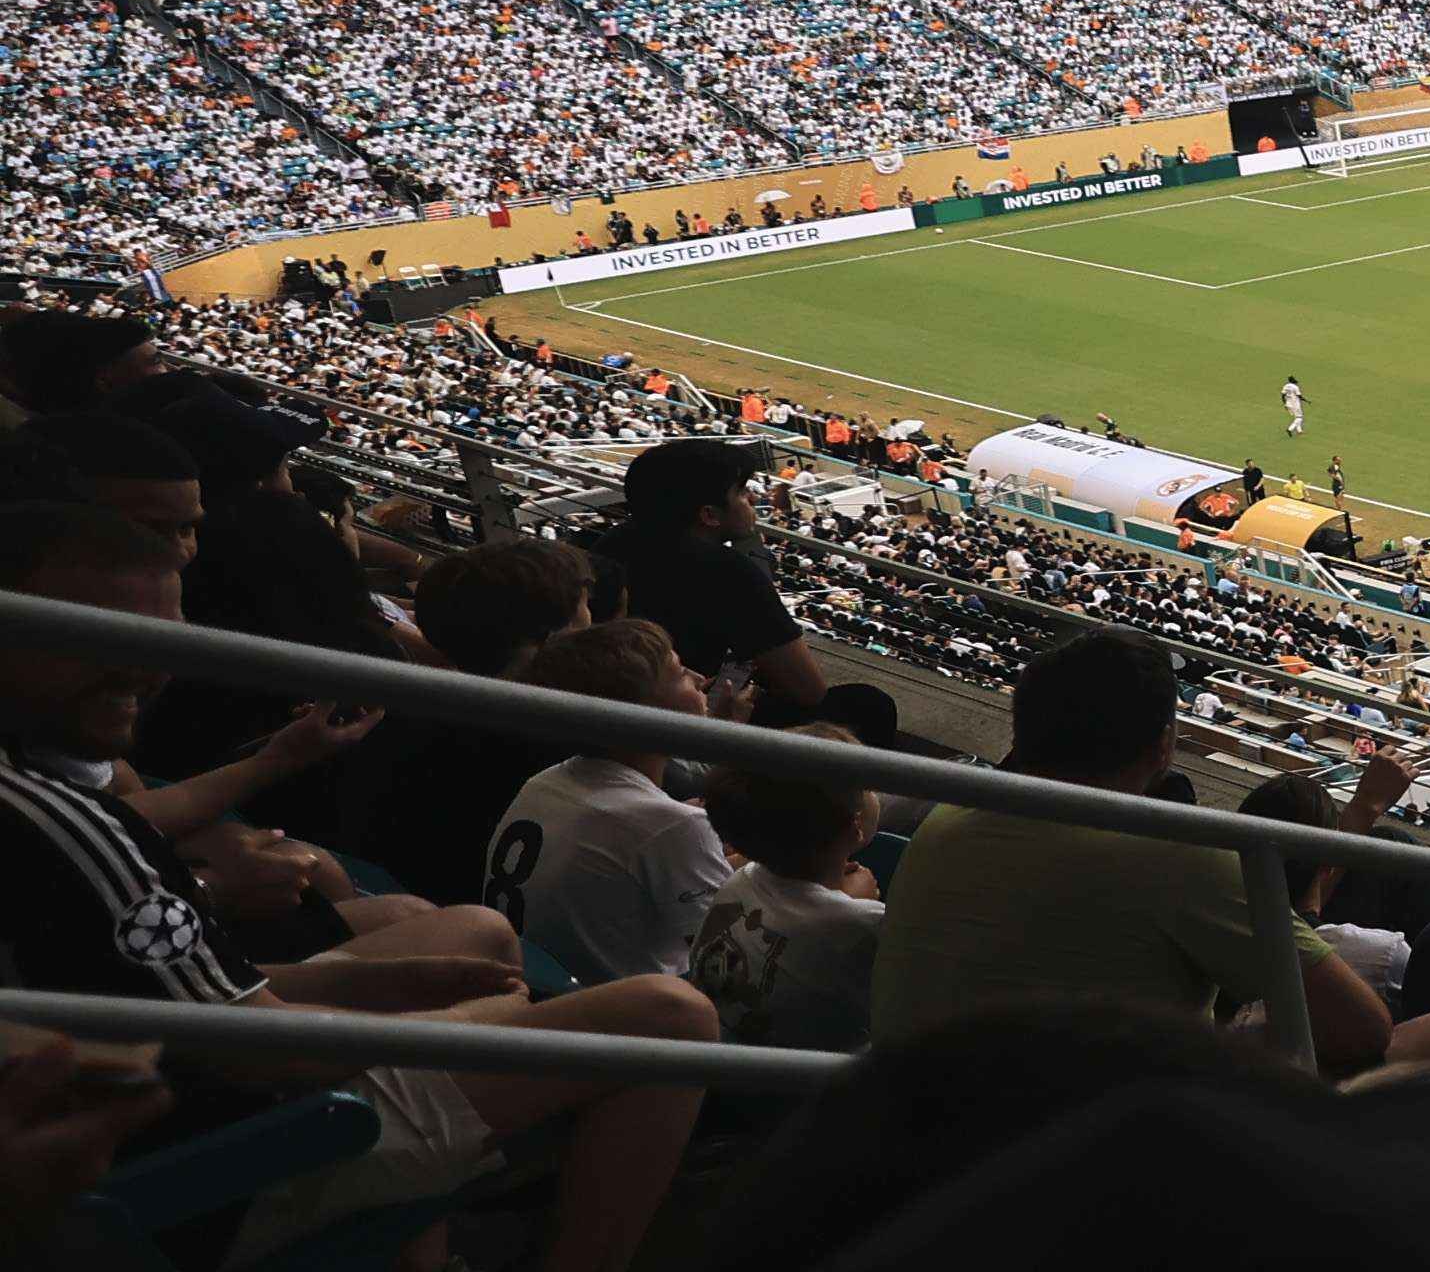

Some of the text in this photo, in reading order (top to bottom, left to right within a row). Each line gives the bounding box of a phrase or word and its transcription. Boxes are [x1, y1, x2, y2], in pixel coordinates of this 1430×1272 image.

[1003, 174, 1163, 210] INVESTED IN BETTER
[611, 227, 821, 271] INVESTED IN BETTER
[484, 819, 543, 937] 8
